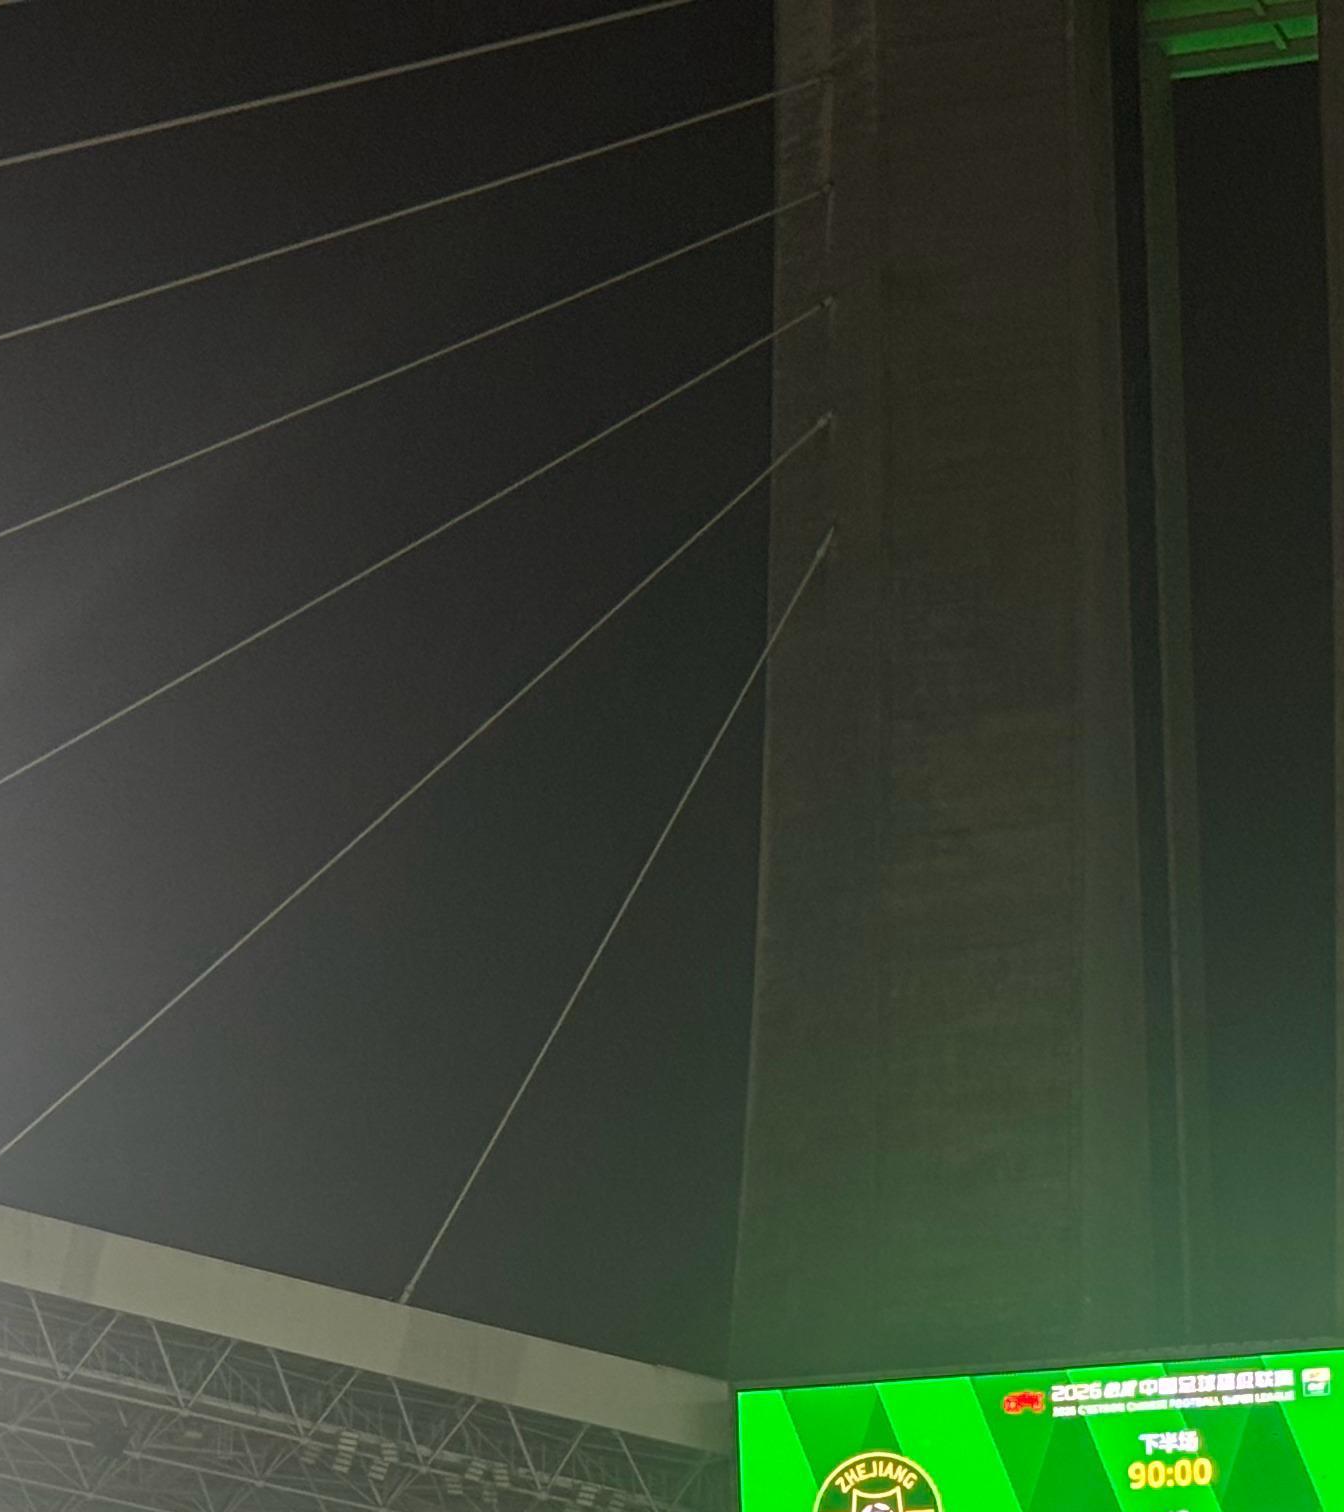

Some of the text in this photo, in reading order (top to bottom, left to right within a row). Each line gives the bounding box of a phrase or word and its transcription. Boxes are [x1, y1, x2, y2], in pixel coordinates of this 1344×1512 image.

[1138, 1430, 1199, 1455] 下半场
[835, 1461, 918, 1493] ZHEJIANG
[1127, 1458, 1212, 1489] 90:00
